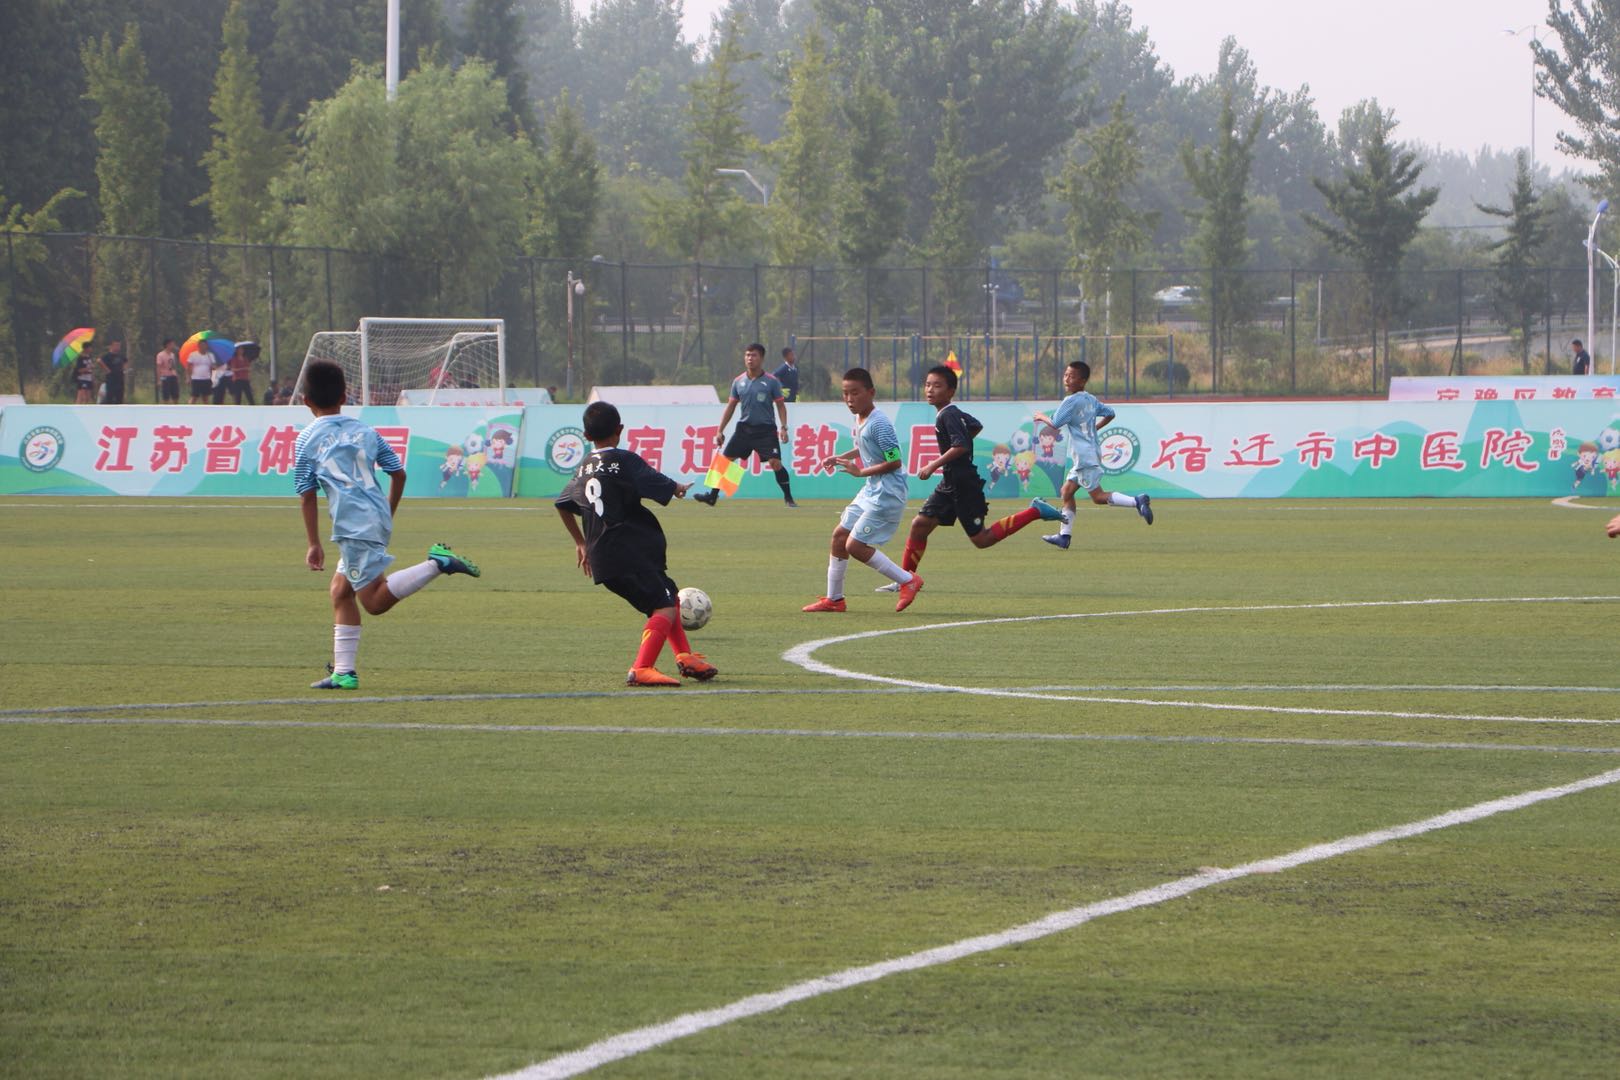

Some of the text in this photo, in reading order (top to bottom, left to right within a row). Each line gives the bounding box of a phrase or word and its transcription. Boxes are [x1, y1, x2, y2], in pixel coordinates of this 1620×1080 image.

[95, 425, 409, 473] 江苏省体局
[627, 424, 944, 475] 宿迁教局
[1152, 431, 1538, 472] 宿迁市中医院
